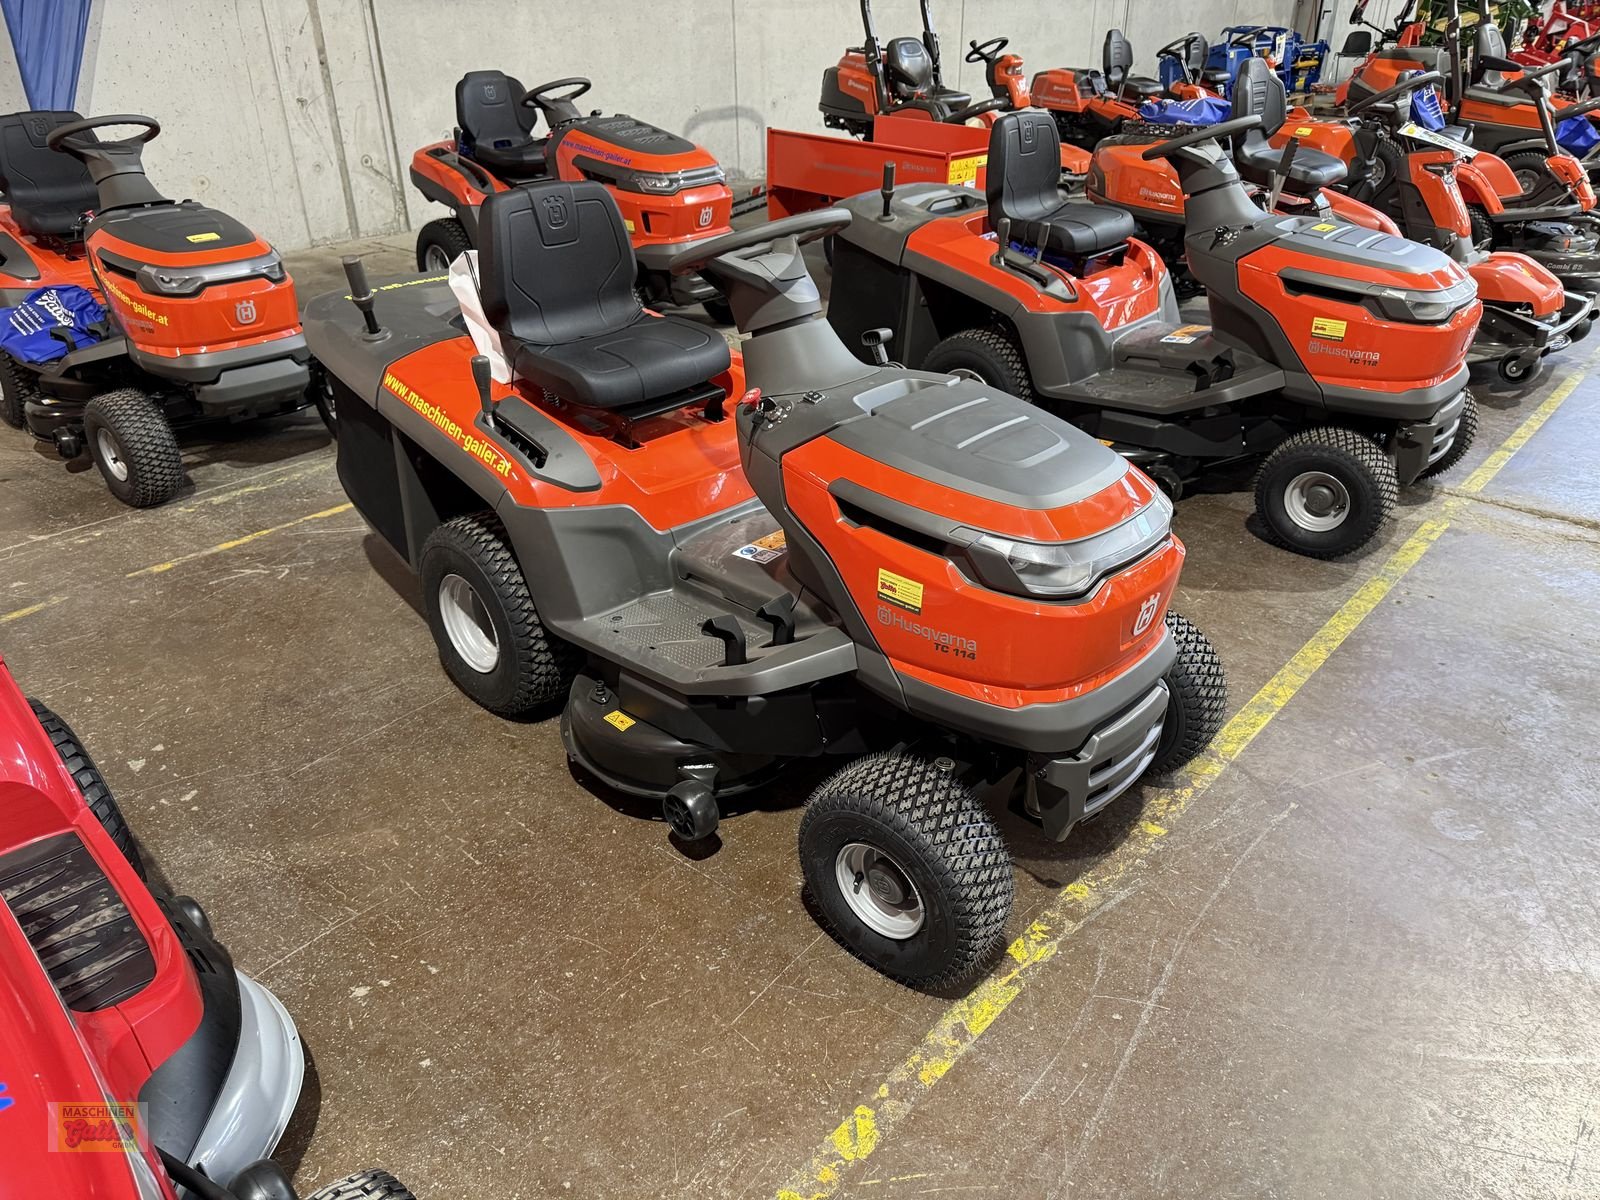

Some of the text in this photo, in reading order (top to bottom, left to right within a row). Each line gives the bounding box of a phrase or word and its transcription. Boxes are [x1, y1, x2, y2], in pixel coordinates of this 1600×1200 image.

[1320, 344, 1380, 361] Husqvarna
[1349, 357, 1379, 368] TC 112
[384, 372, 512, 478] www.maschinen-gailer.at
[892, 612, 977, 652] Husqvarna
[934, 642, 976, 661] TC 114
